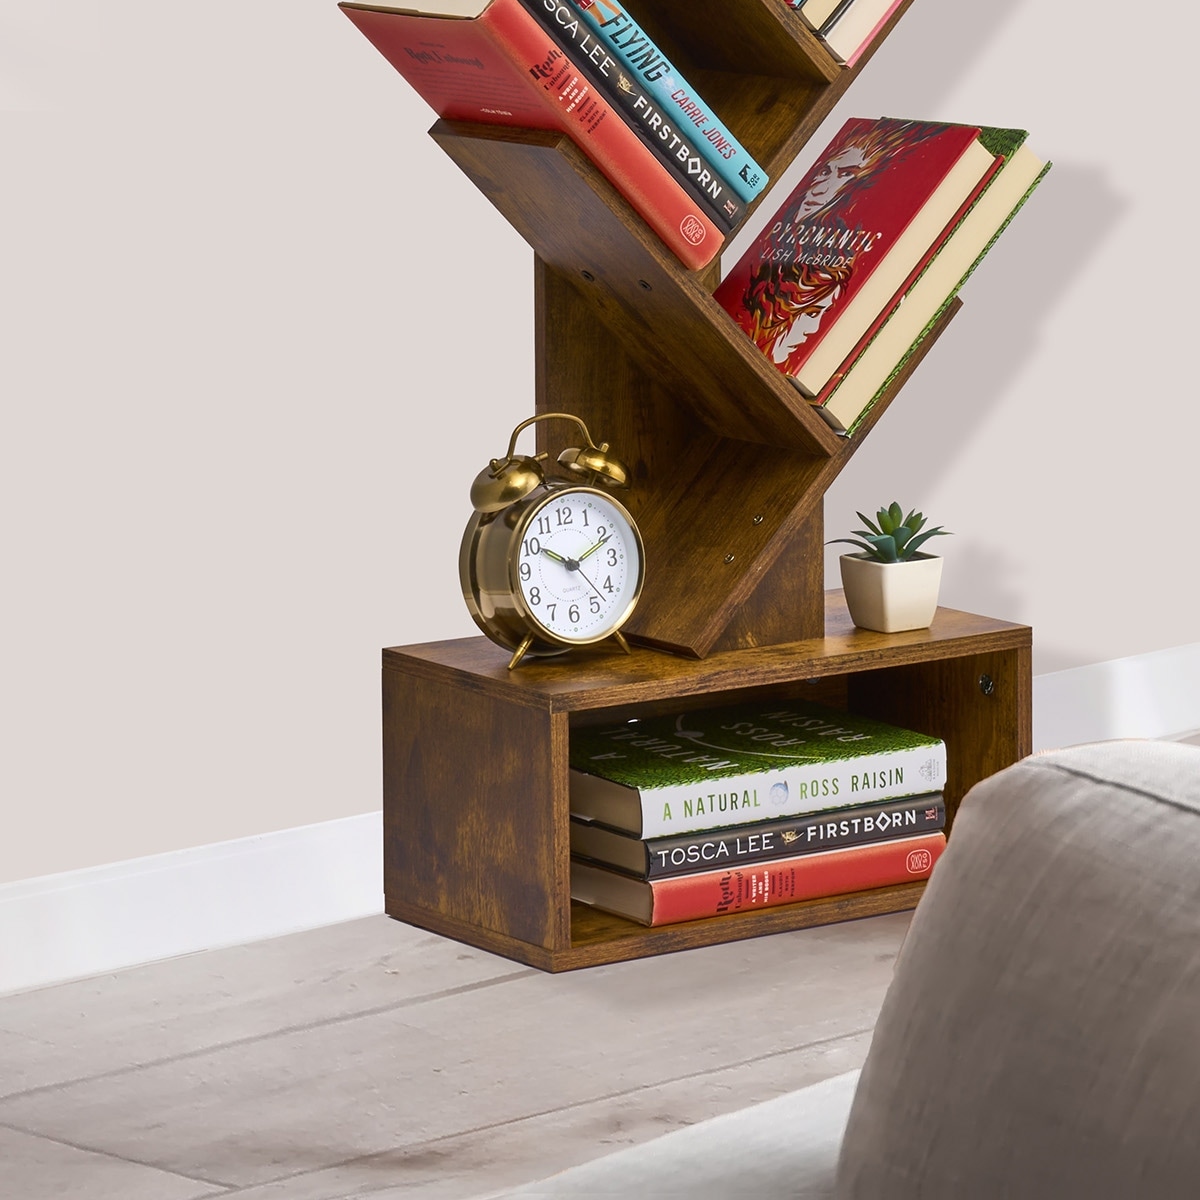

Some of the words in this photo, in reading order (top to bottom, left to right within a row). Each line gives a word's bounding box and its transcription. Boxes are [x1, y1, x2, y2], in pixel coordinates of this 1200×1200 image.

[579, 34, 616, 77] LEE
[600, 12, 671, 82] FLYING
[671, 89, 710, 128] CARRIE
[702, 127, 737, 160] JONES
[633, 95, 723, 200] FIRSTBORN
[765, 222, 882, 252] PYROMANTIC
[761, 247, 793, 261] LISH
[793, 252, 853, 269] McBRIDE
[537, 516, 551, 535] 11
[555, 507, 573, 526] 12
[582, 509, 589, 527] 1
[597, 526, 607, 544] 2
[524, 537, 541, 557] 10
[607, 548, 617, 567] 3
[520, 562, 531, 581] 9
[562, 585, 581, 593] QUARTZ
[603, 575, 614, 593] 4
[529, 587, 541, 606] 8
[589, 596, 600, 614] 5
[547, 604, 557, 621] 7
[568, 604, 580, 623] 6
[663, 802, 672, 821] A
[684, 789, 760, 818] NATURAL
[800, 777, 839, 800] ROSS
[851, 767, 904, 792] RAISIN
[657, 841, 729, 867] TOSCA
[737, 833, 774, 854] LEE
[807, 810, 916, 842] FIRSTBORN
